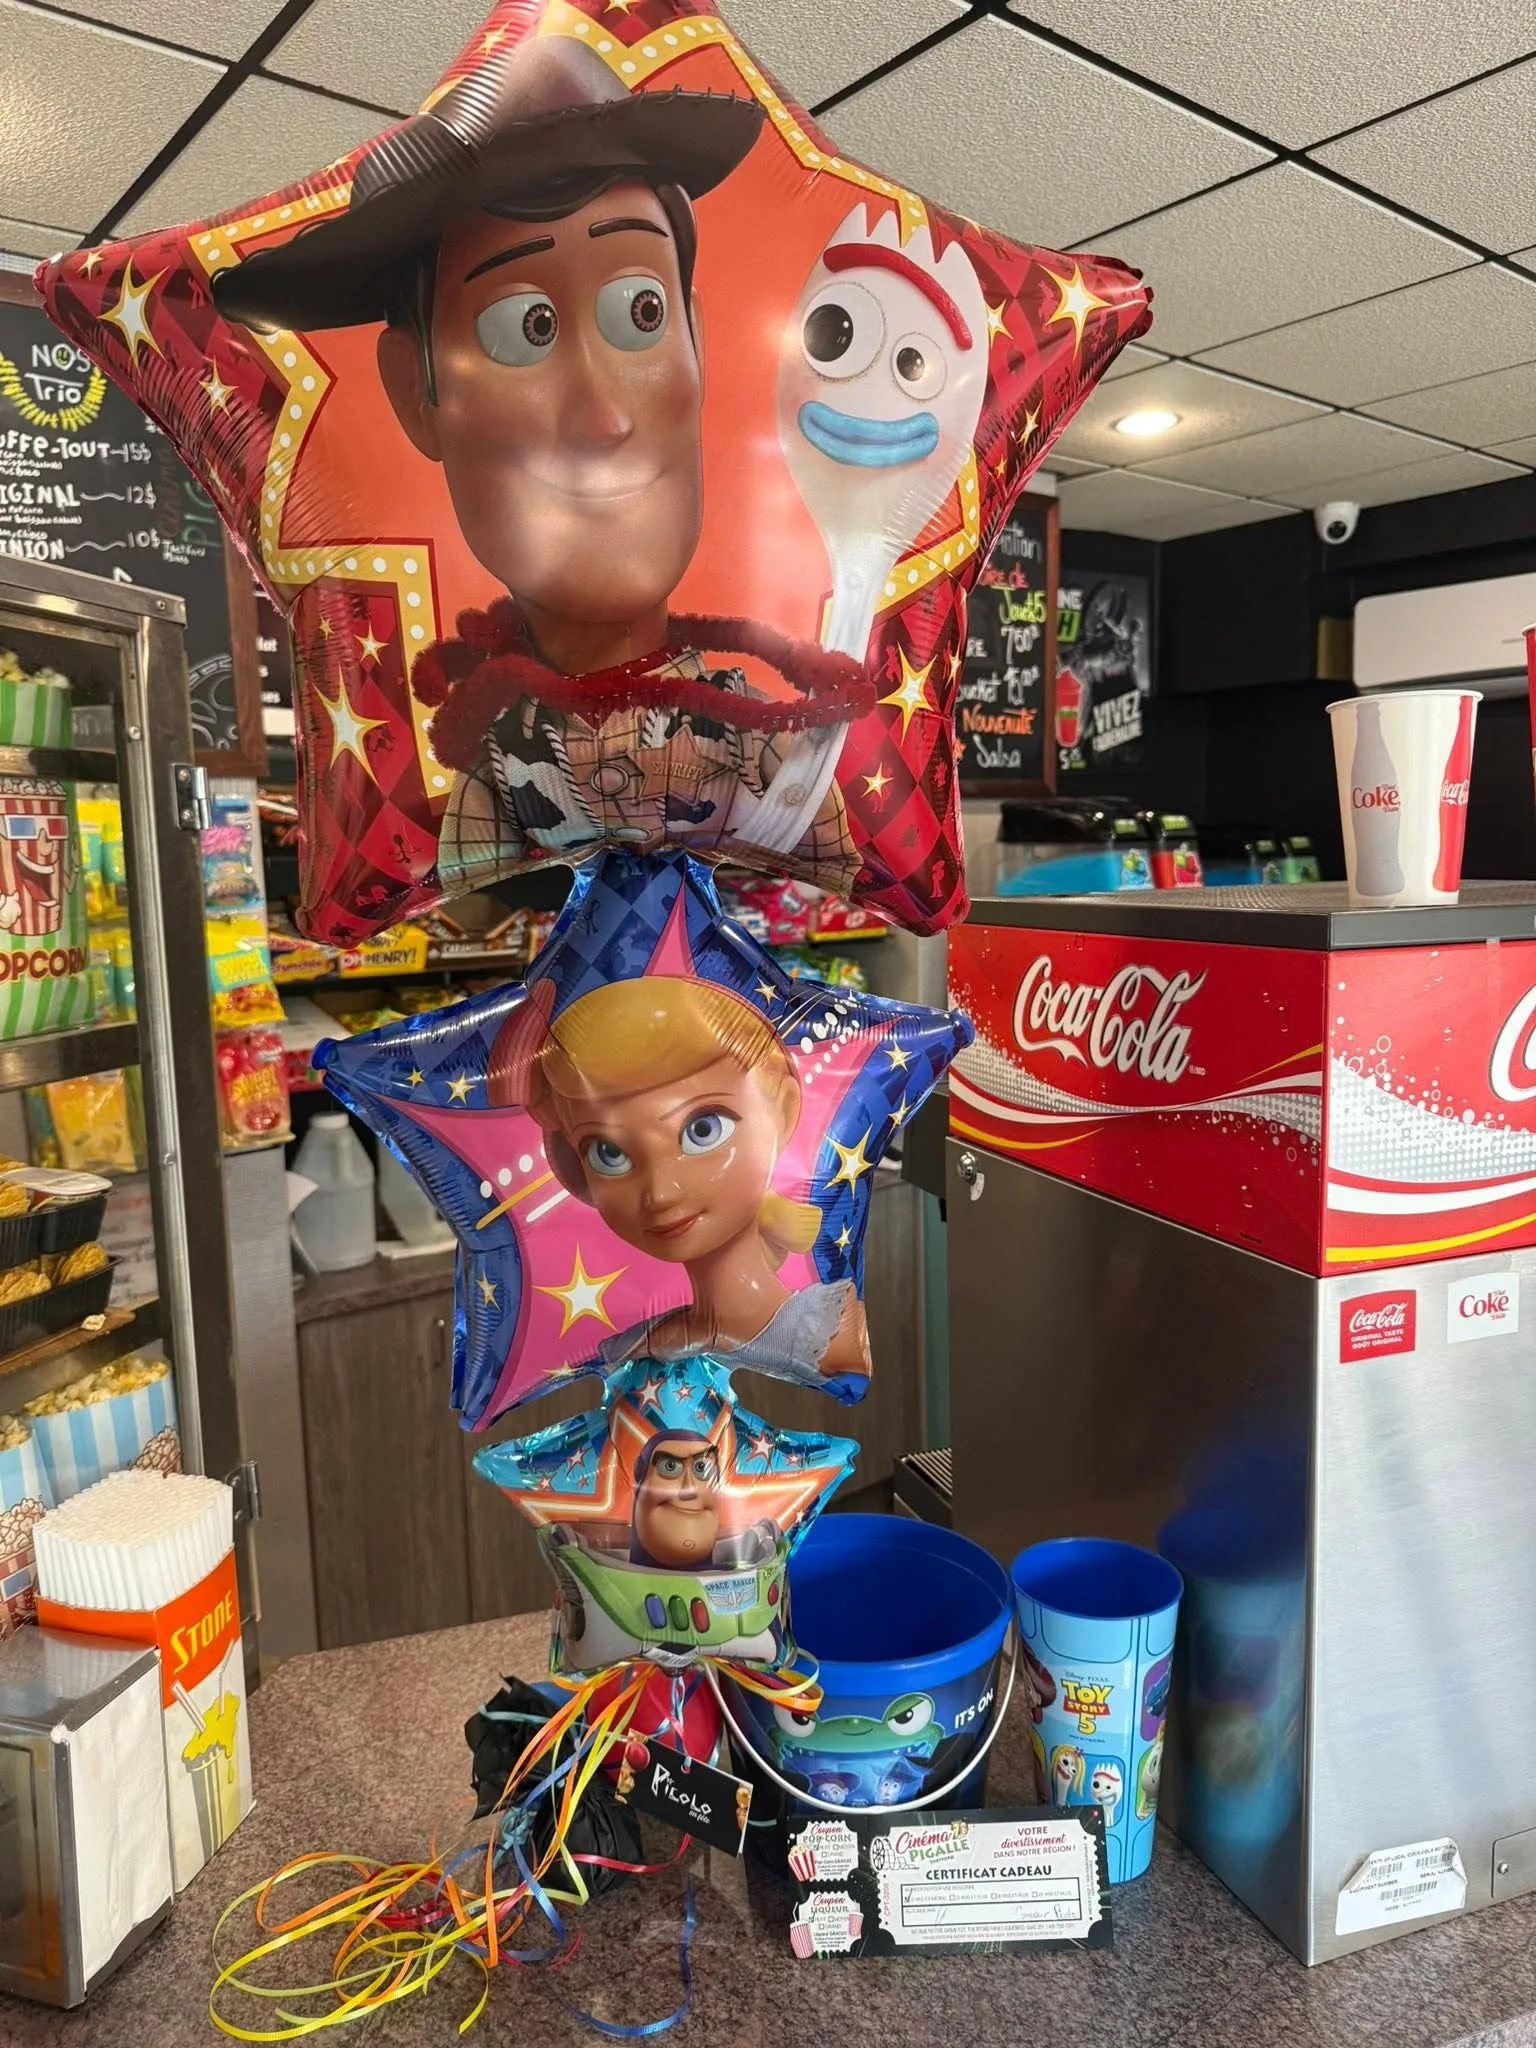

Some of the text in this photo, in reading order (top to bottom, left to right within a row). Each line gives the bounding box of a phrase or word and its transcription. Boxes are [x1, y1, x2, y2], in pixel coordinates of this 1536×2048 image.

[32, 343, 91, 372] NOS
[24, 372, 84, 404] Trio
[1352, 785, 1401, 809] Coke
[1012, 954, 1209, 1083] Coca-Cola
[1459, 1292, 1509, 1318] Coke
[1349, 1302, 1409, 1332] Coca-Cola
[704, 1581, 729, 1592] SPACE
[171, 1589, 234, 1676] STONE
[977, 1687, 994, 1713] ON
[1067, 1701, 1106, 1713] STORY
[1078, 1712, 1097, 1735] 5
[810, 1823, 845, 1836] Coupon
[1000, 1833, 1067, 1849] divertissement
[1017, 1826, 1048, 1836] VOTRE
[896, 1829, 952, 1854] Cinéma
[908, 1838, 970, 1862] PIGALLE
[993, 1849, 1015, 1859] DANS
[1016, 1847, 1041, 1857] NOTRE
[1042, 1845, 1072, 1854] RÉGION
[926, 1864, 1053, 1880] CERTIFICAT CADEAU
[810, 1906, 850, 1914] LIQUEUR
[812, 1894, 846, 1907] Coupon
